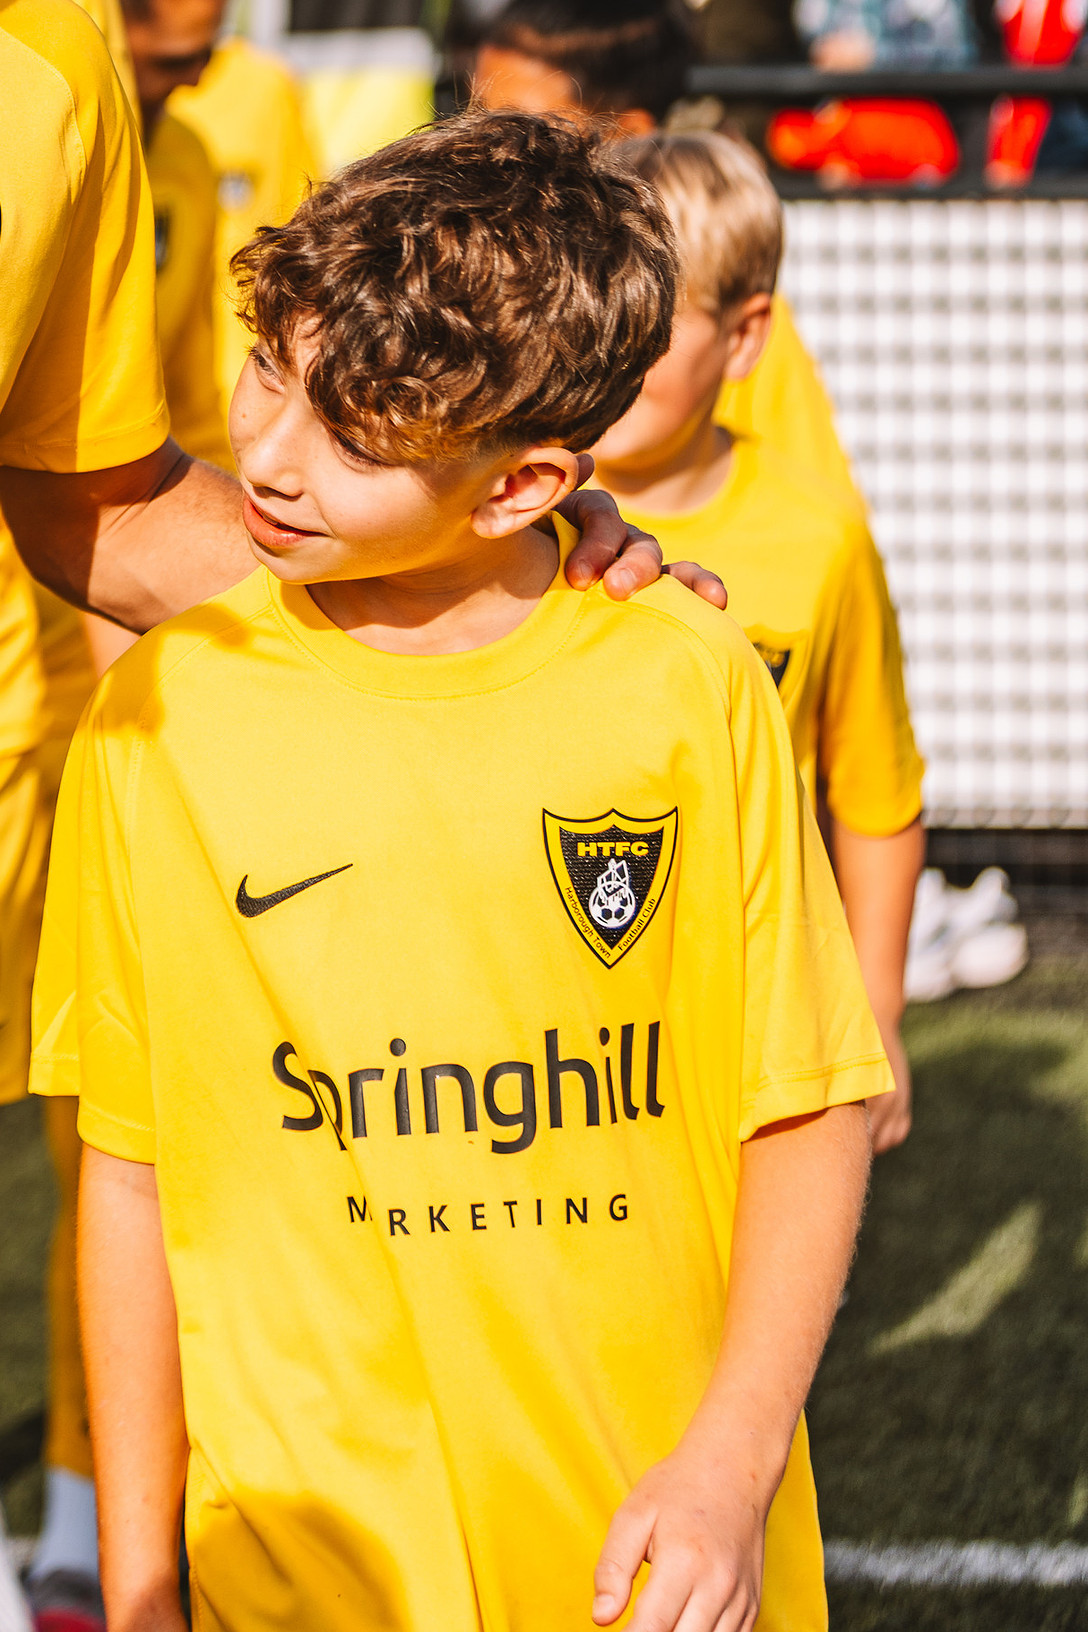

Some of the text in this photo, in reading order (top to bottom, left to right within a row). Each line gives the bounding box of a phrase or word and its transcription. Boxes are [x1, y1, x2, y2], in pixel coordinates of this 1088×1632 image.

[577, 841, 650, 857] HTFC
[565, 886, 611, 959] Harborough Town
[617, 898, 656, 951] Football Club
[346, 1193, 630, 1237] MRKETING
